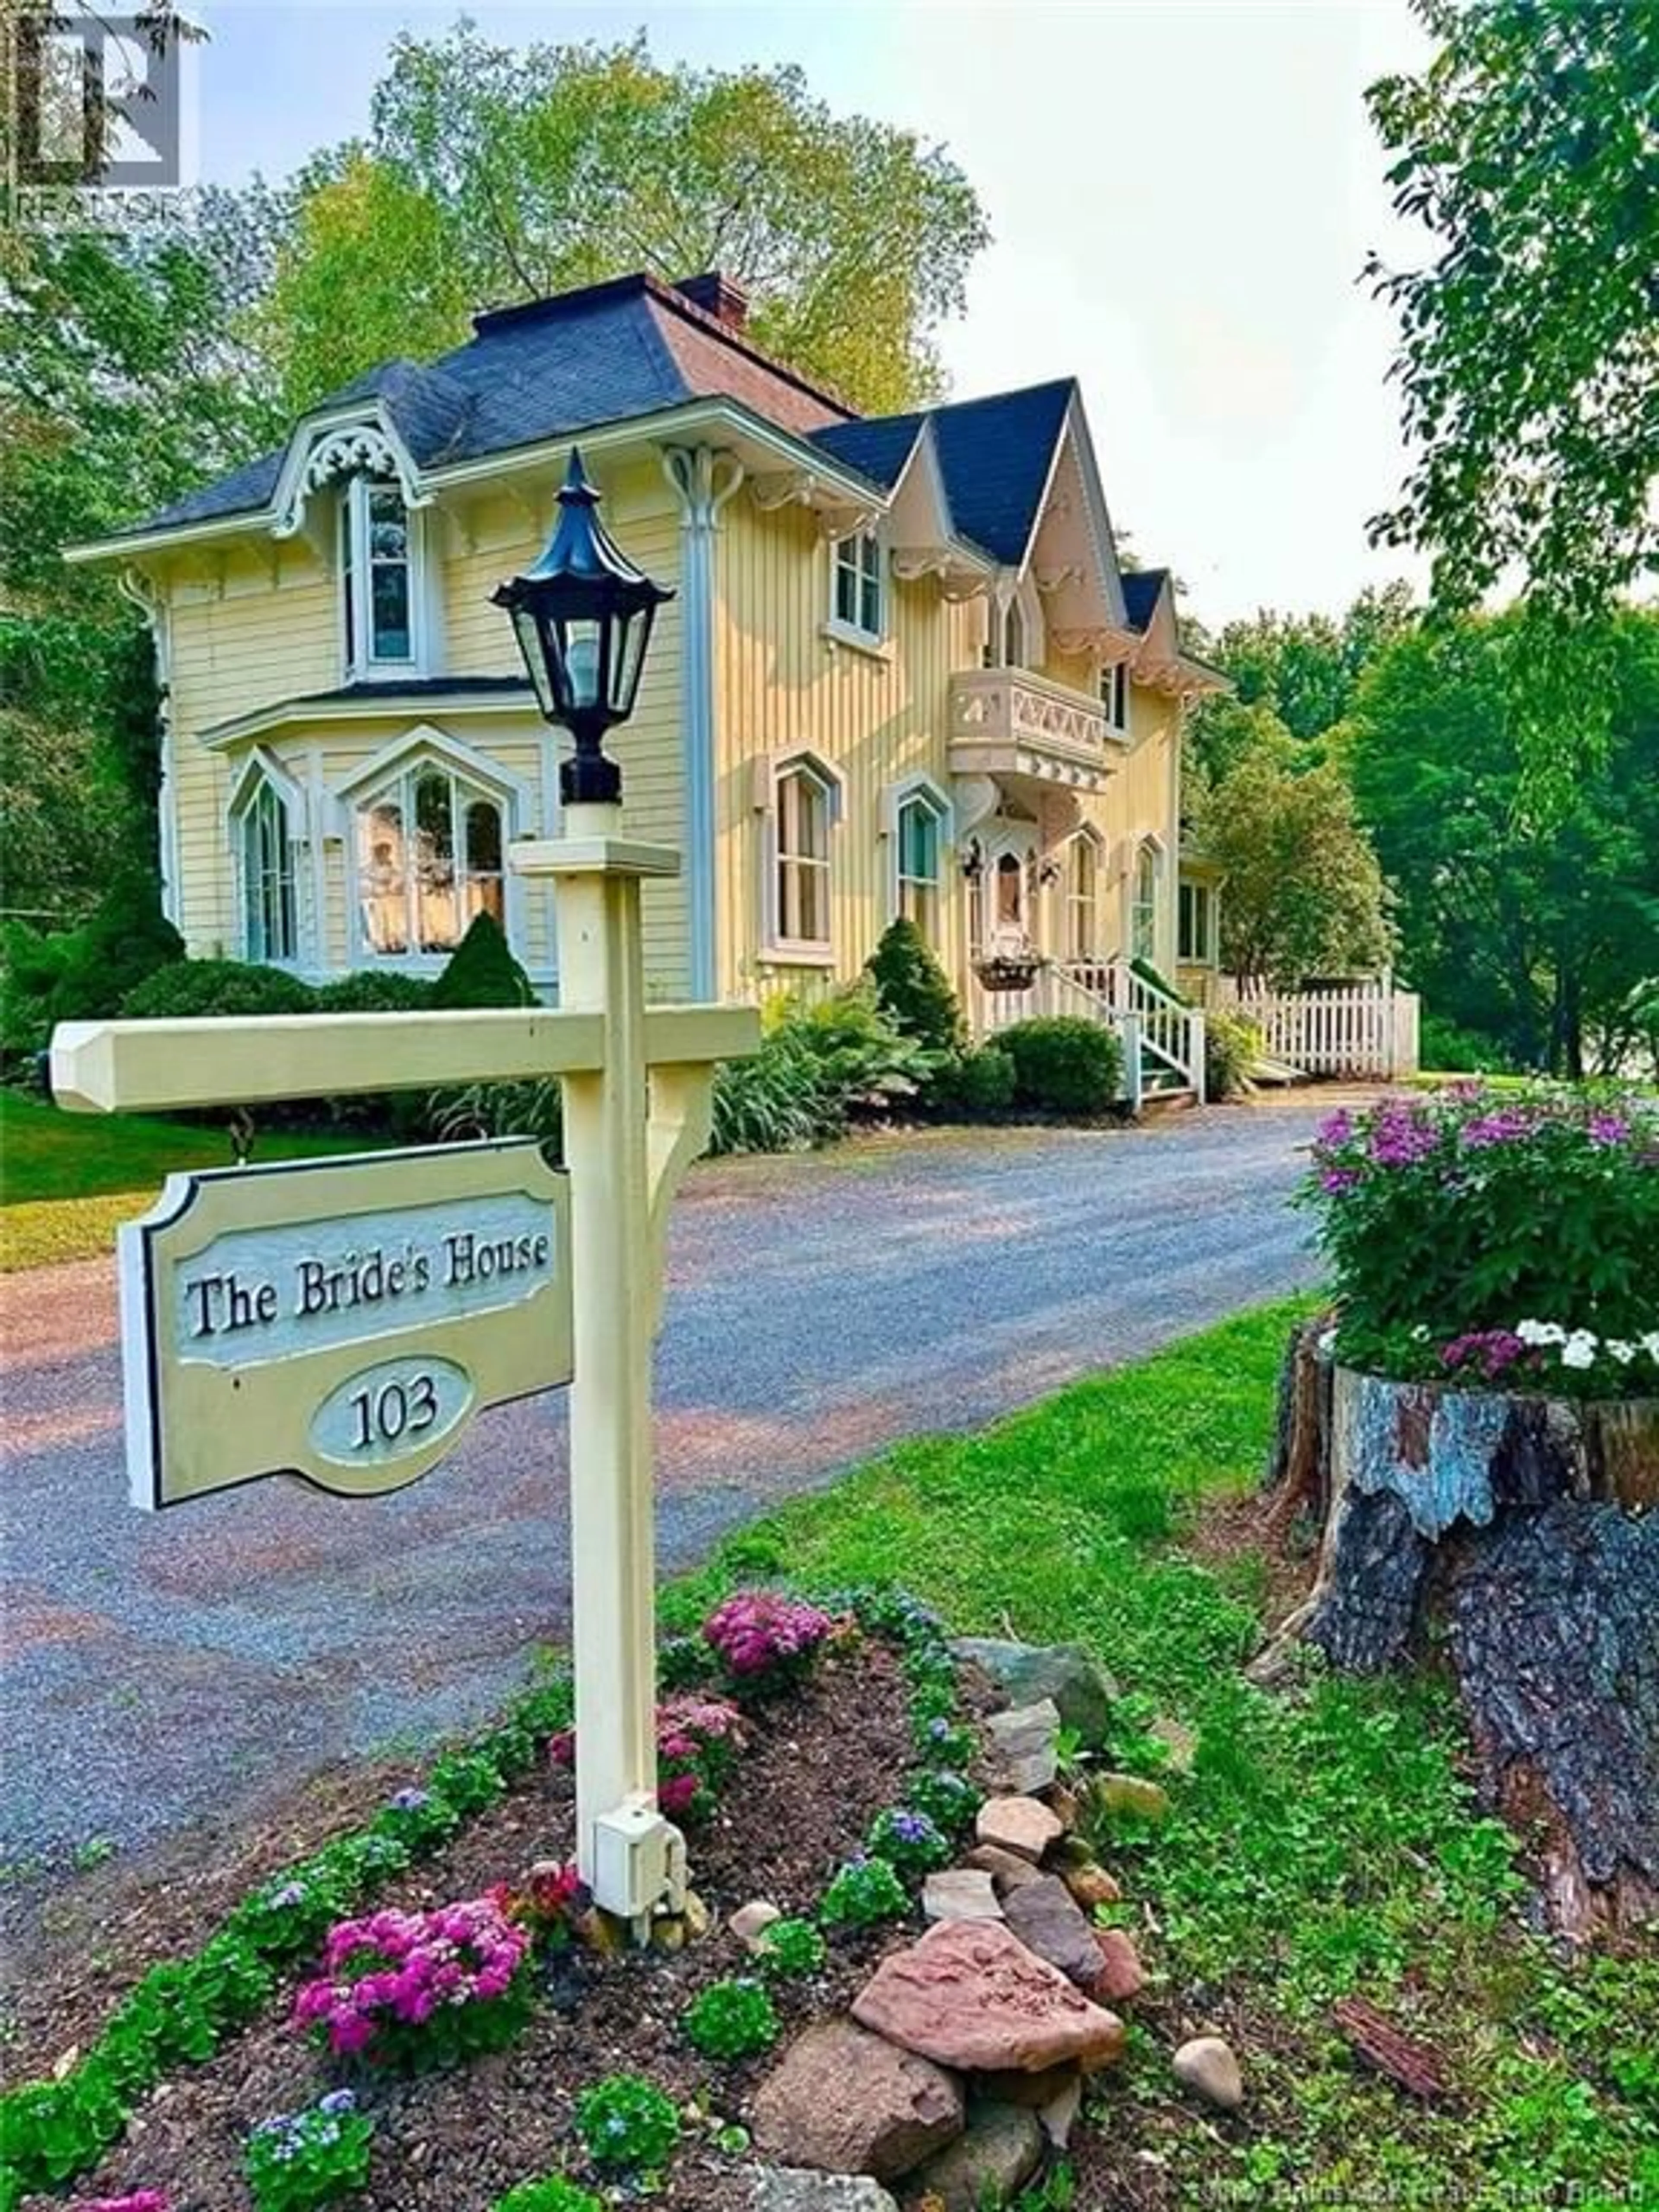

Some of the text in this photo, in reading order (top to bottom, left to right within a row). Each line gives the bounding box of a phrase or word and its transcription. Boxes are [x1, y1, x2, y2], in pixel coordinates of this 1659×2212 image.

[187, 1233, 549, 1337] The Bride's House
[351, 1375, 437, 1450] 103
